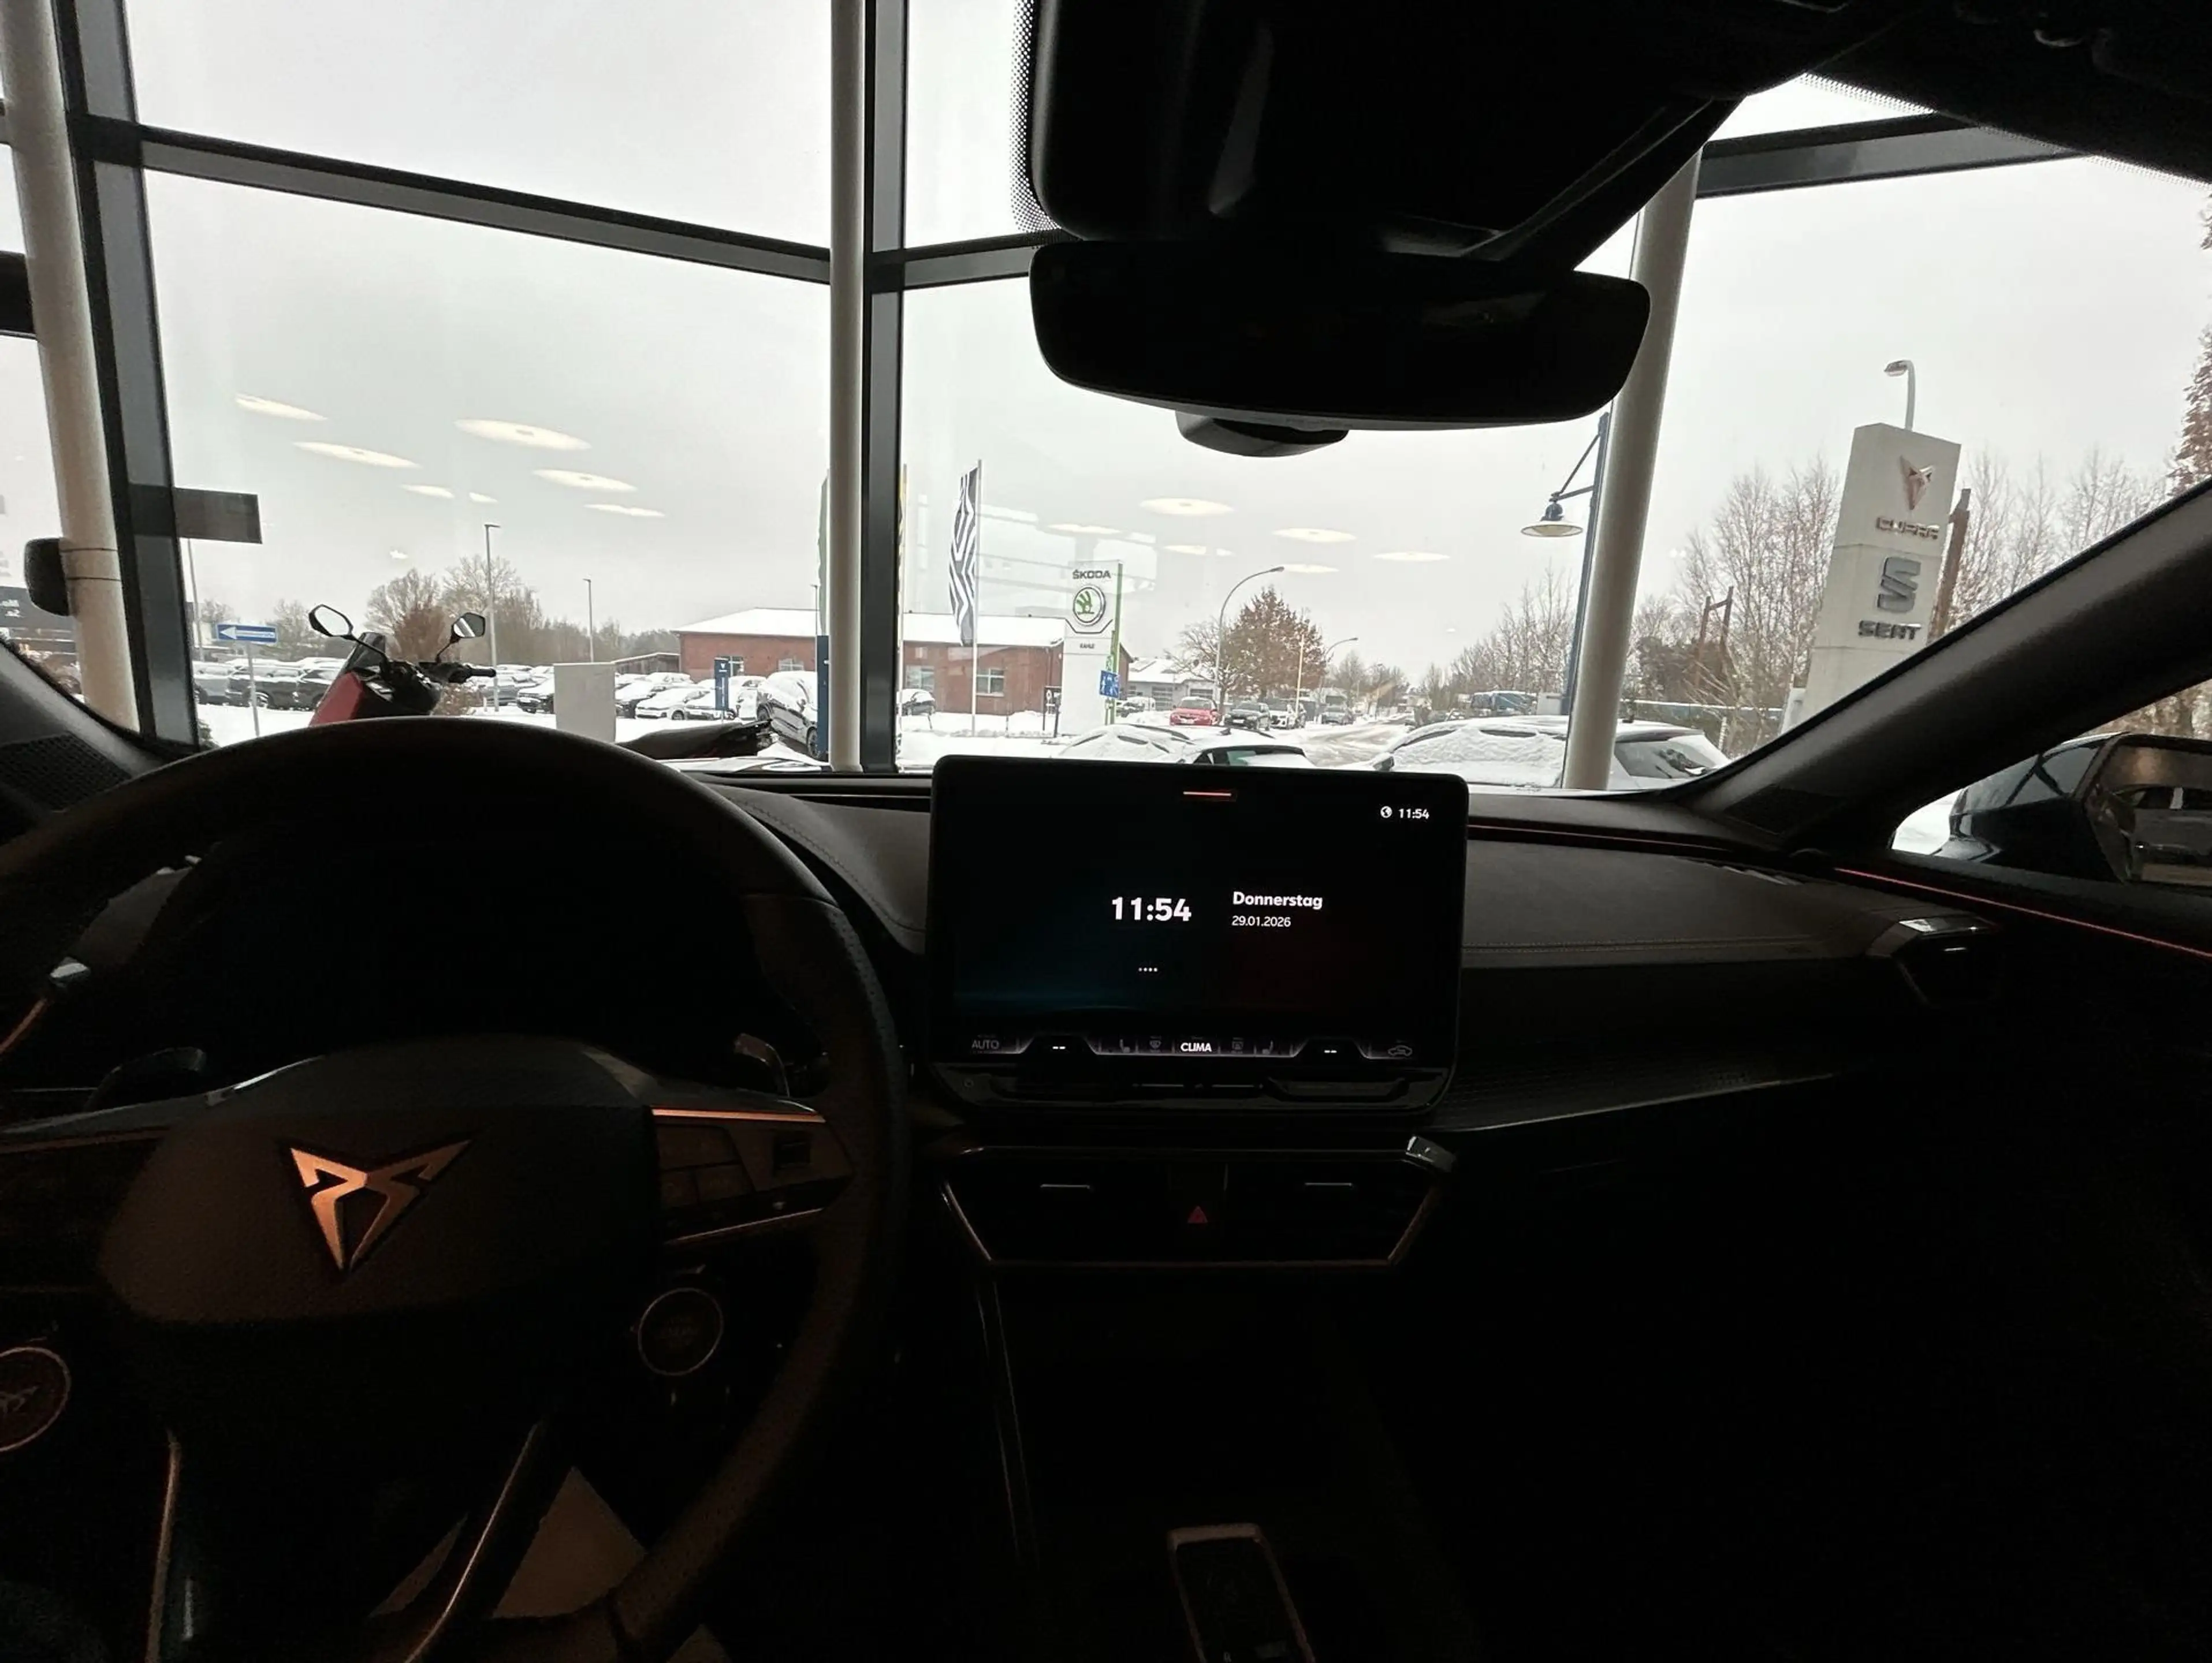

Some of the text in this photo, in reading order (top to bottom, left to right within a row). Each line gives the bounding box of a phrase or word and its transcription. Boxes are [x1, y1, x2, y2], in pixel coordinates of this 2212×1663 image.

[1073, 569, 1111, 579] ŠKODA
[1399, 808, 1429, 819] 11:54
[1232, 891, 1323, 910] Donnerstag
[1112, 897, 1191, 922] 11:54
[1231, 915, 1291, 927] 29.01.2026
[971, 1040, 999, 1050] AUTO
[1180, 1042, 1212, 1052] CLIMA
